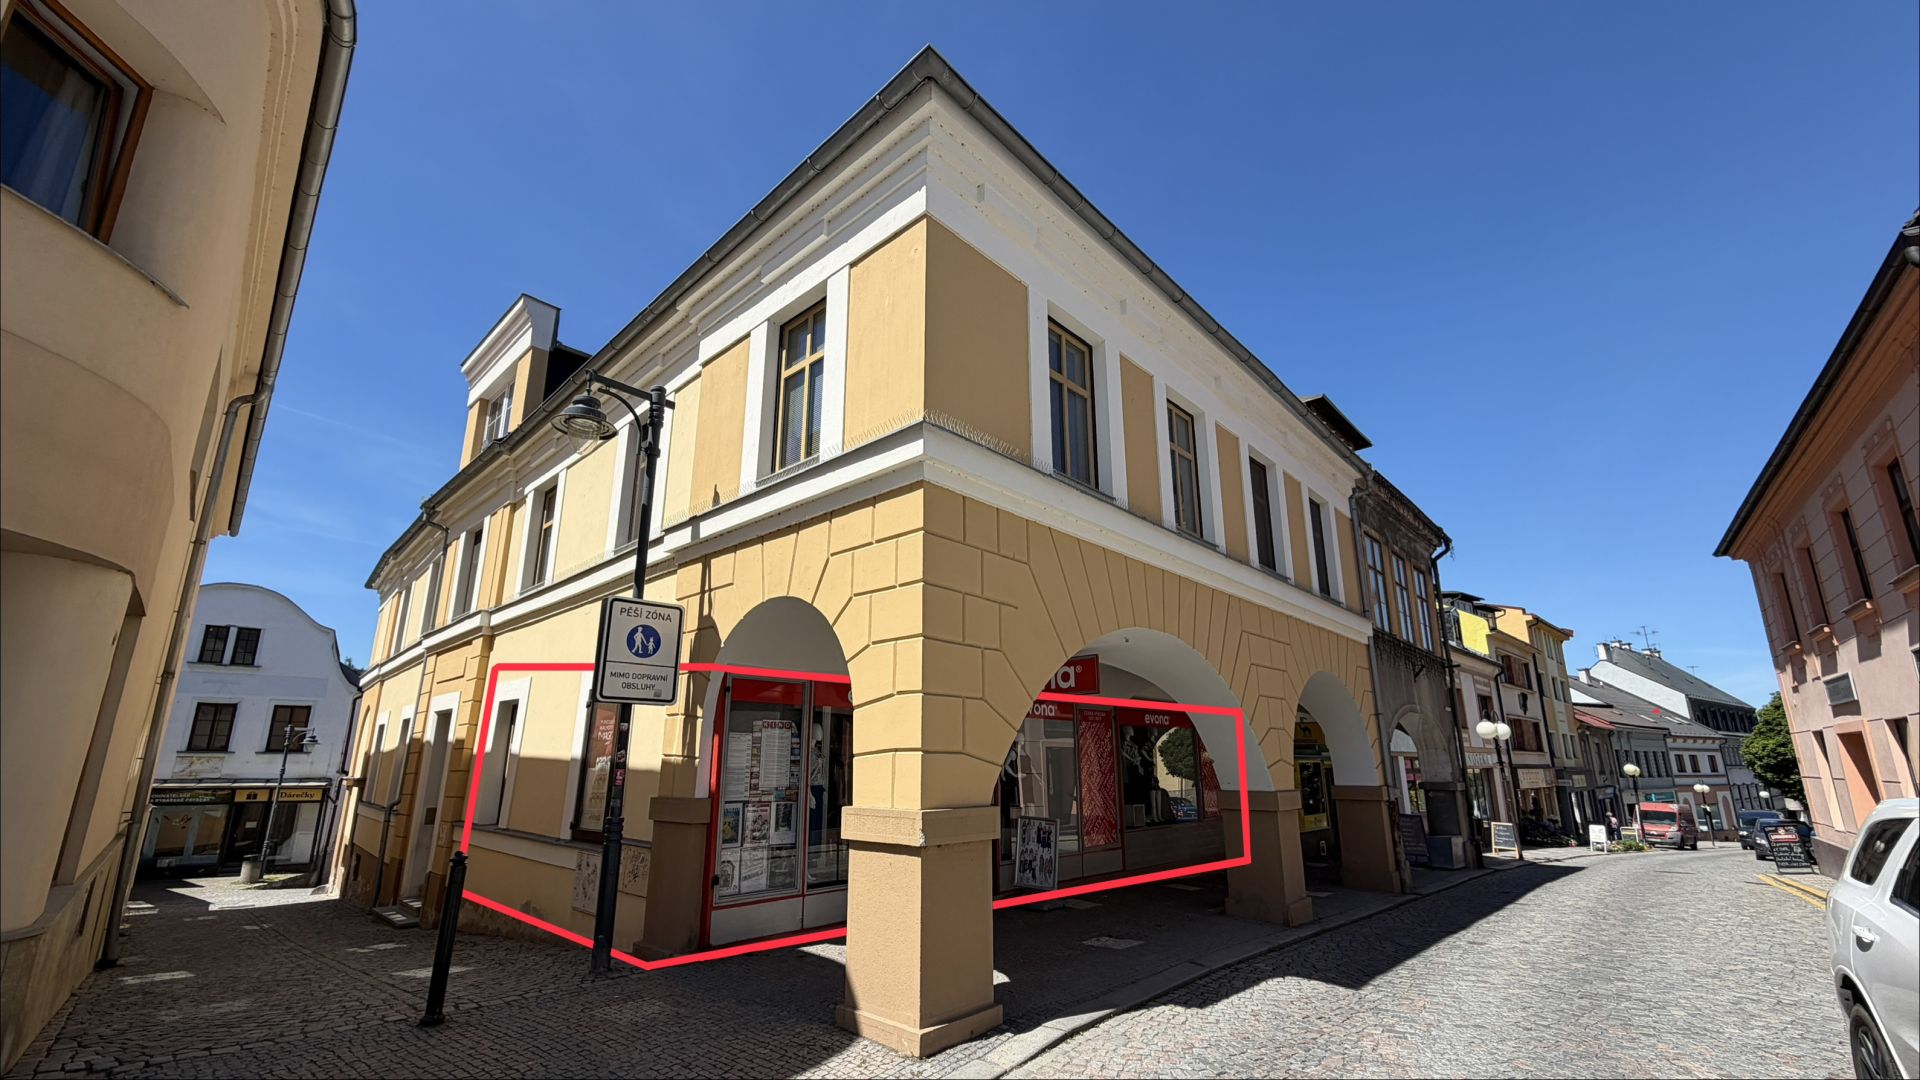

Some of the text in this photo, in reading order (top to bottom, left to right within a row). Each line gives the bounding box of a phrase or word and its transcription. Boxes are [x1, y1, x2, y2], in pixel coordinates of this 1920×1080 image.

[619, 606, 672, 623] PĚŠÍ ZÓNA
[610, 671, 669, 682] MIMO DOPRAVNÍ
[621, 682, 656, 691] OBSLUHY
[1144, 713, 1169, 725] evona
[763, 721, 791, 729] KINO
[280, 791, 315, 799] Dárečky
